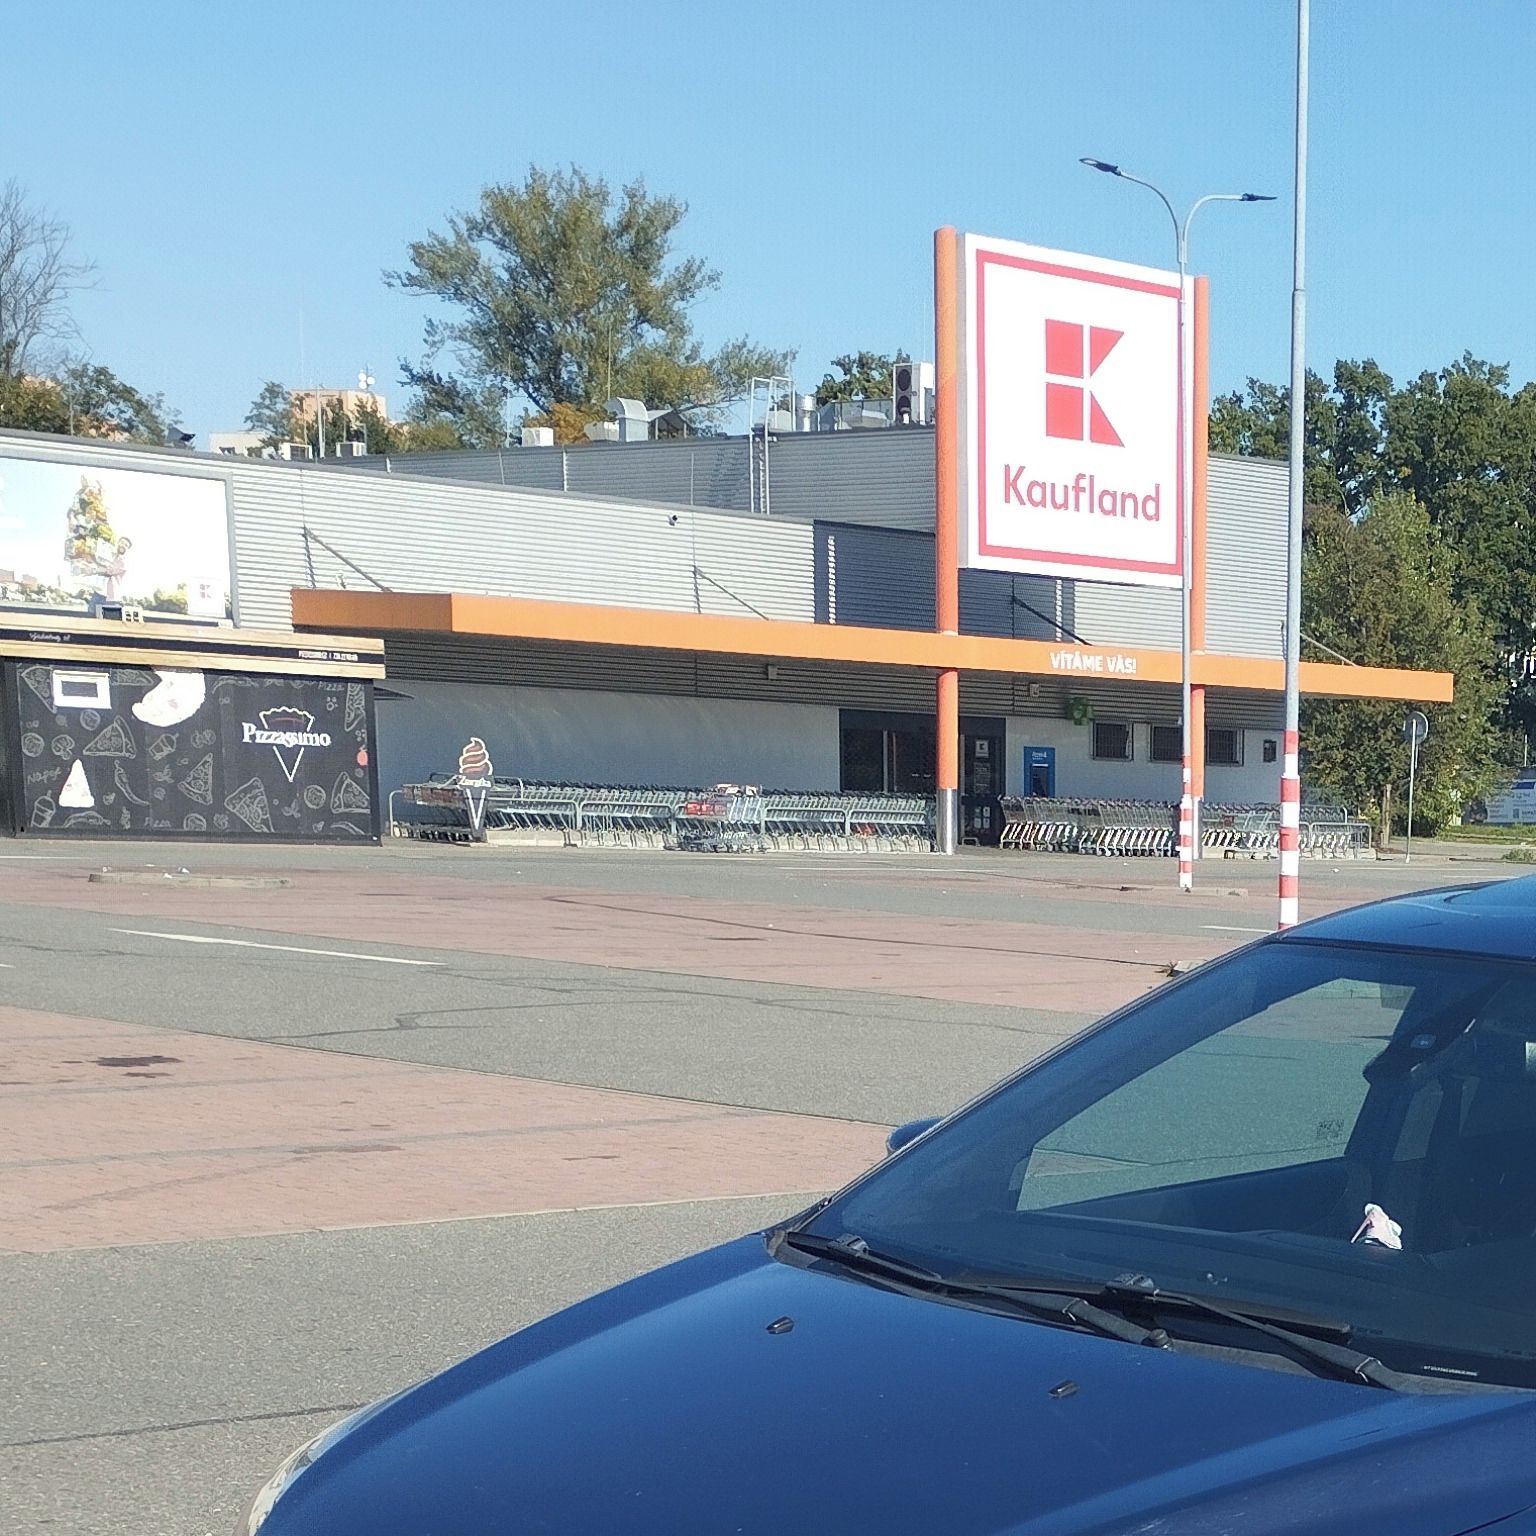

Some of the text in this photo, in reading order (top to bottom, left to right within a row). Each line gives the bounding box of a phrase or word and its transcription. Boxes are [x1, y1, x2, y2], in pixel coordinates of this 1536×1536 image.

[1004, 464, 1160, 522] Kaufland
[1049, 650, 1137, 674] VÍTÁME VÁS!
